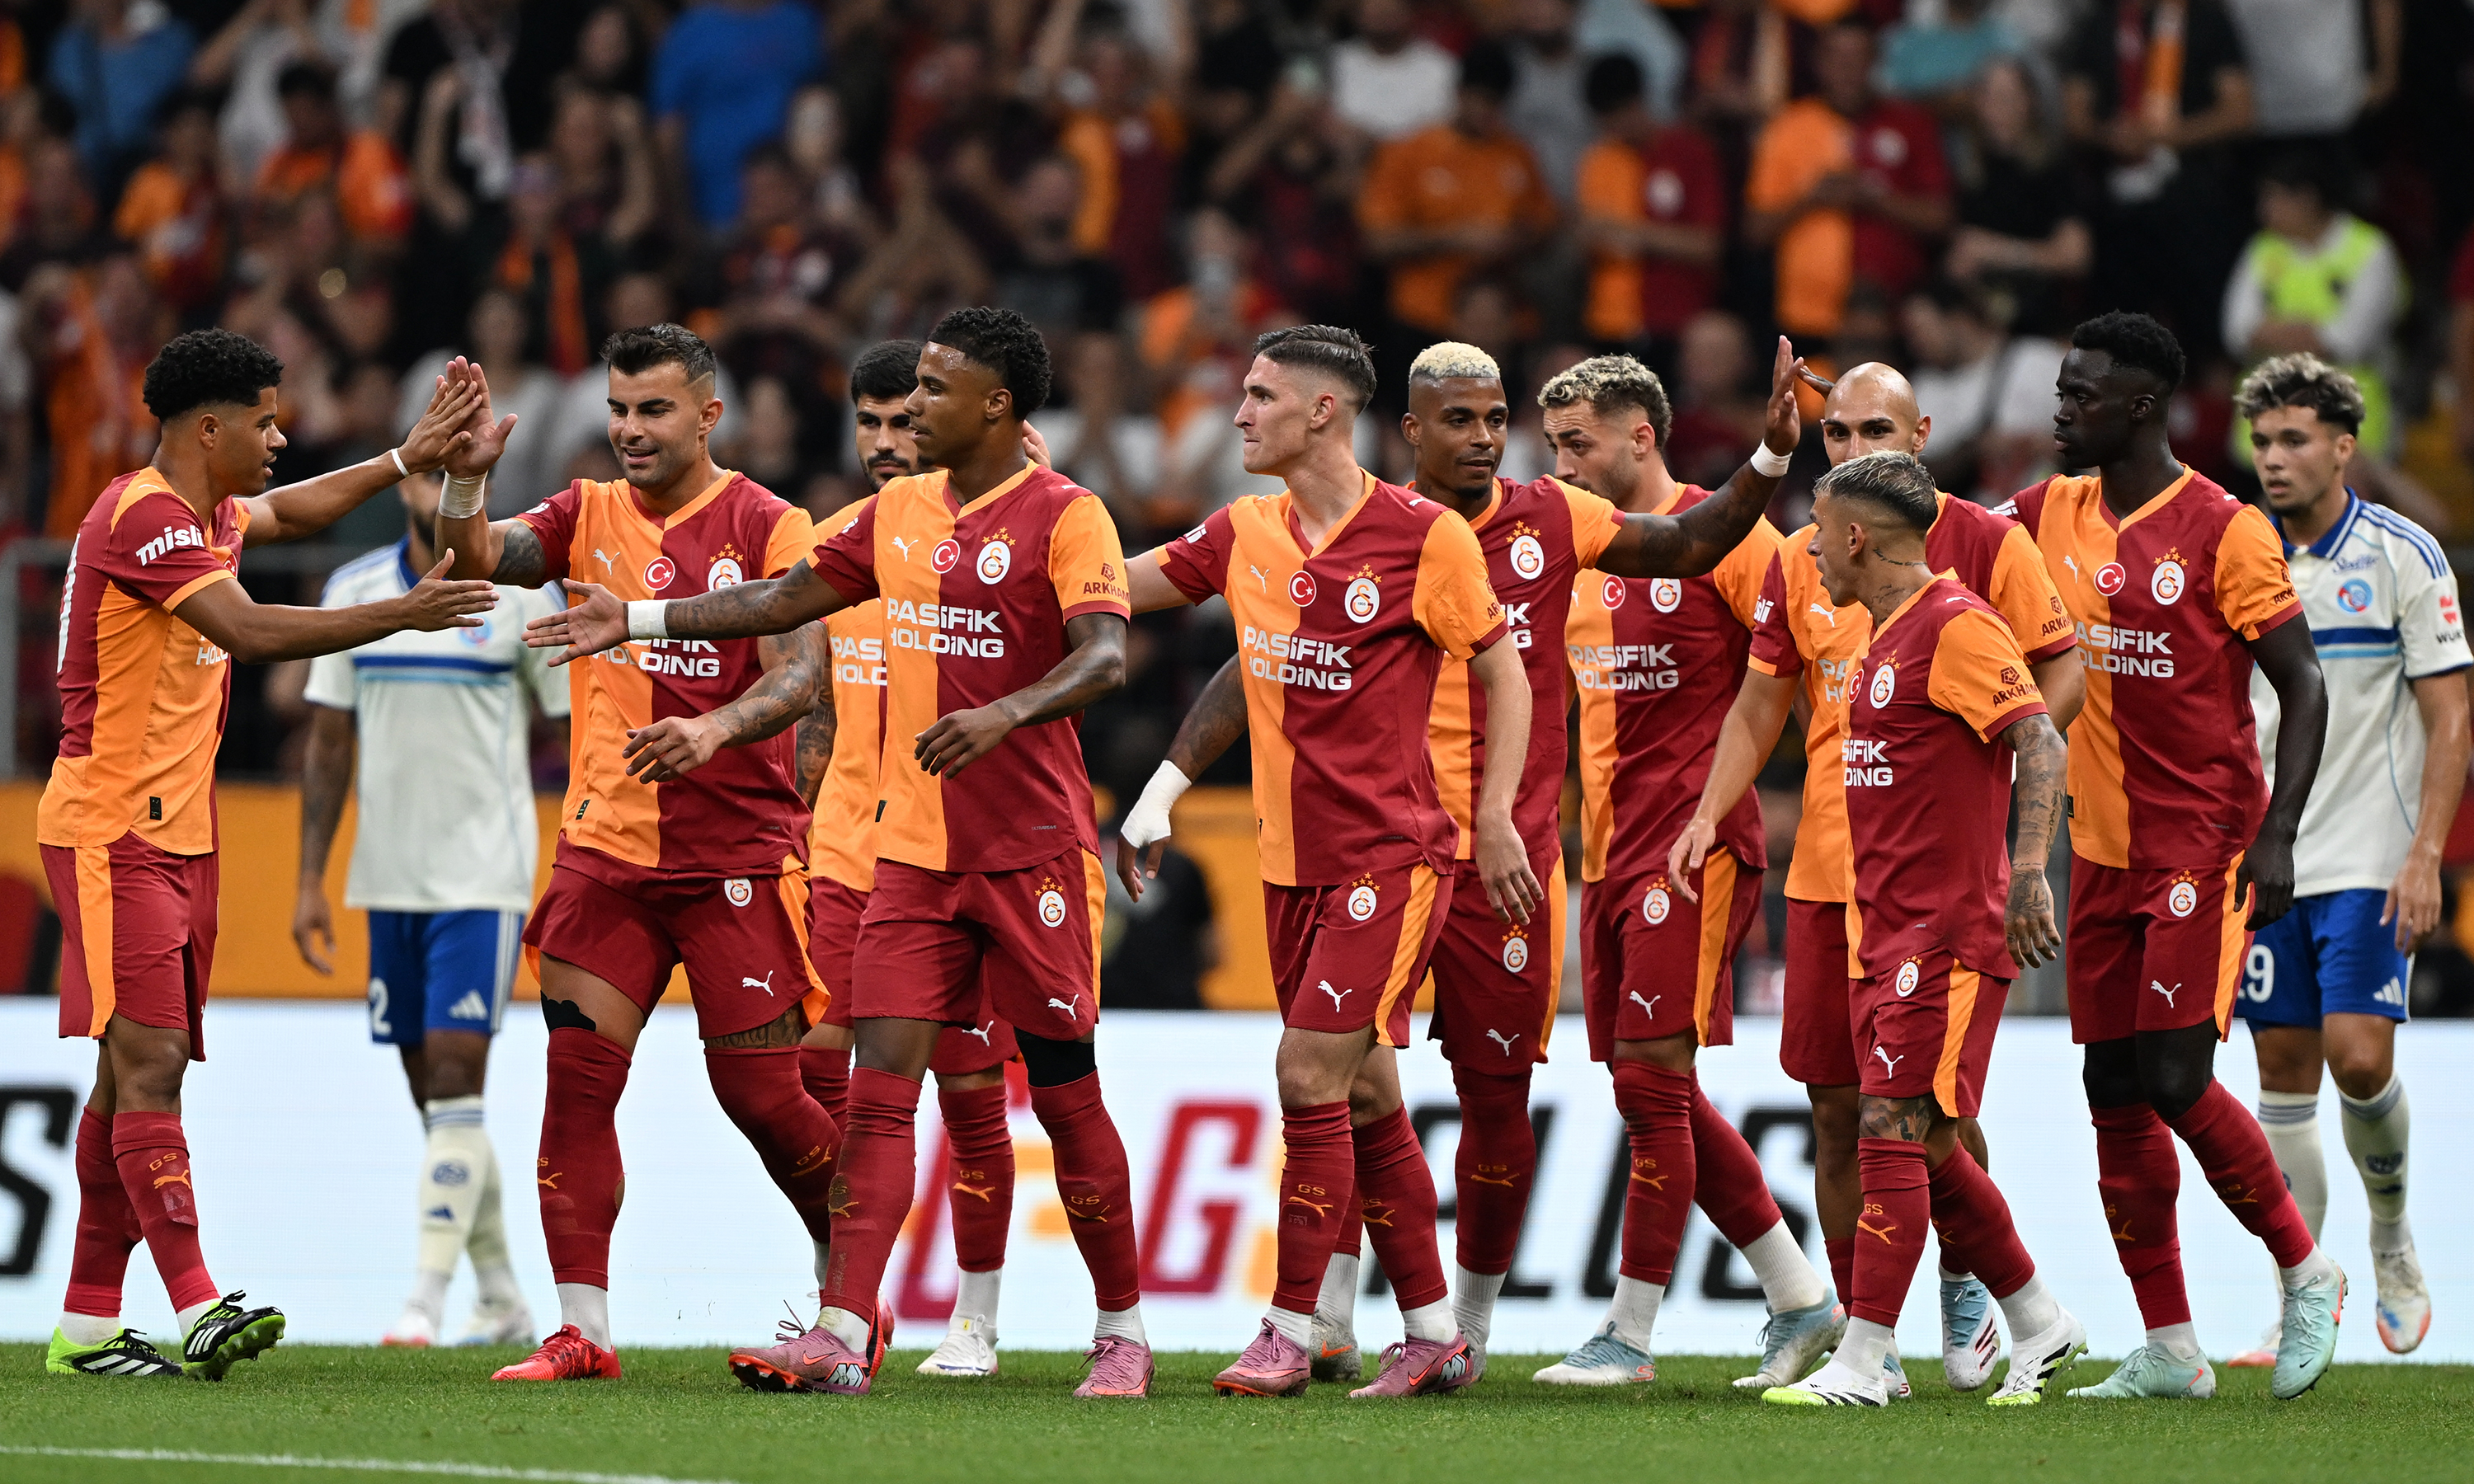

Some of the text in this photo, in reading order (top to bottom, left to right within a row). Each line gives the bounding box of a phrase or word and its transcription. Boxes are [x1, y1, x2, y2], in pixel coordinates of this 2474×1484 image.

[135, 524, 205, 566] misli
[1298, 1184, 1326, 1196] GS
[1864, 1203, 1884, 1215] GS
